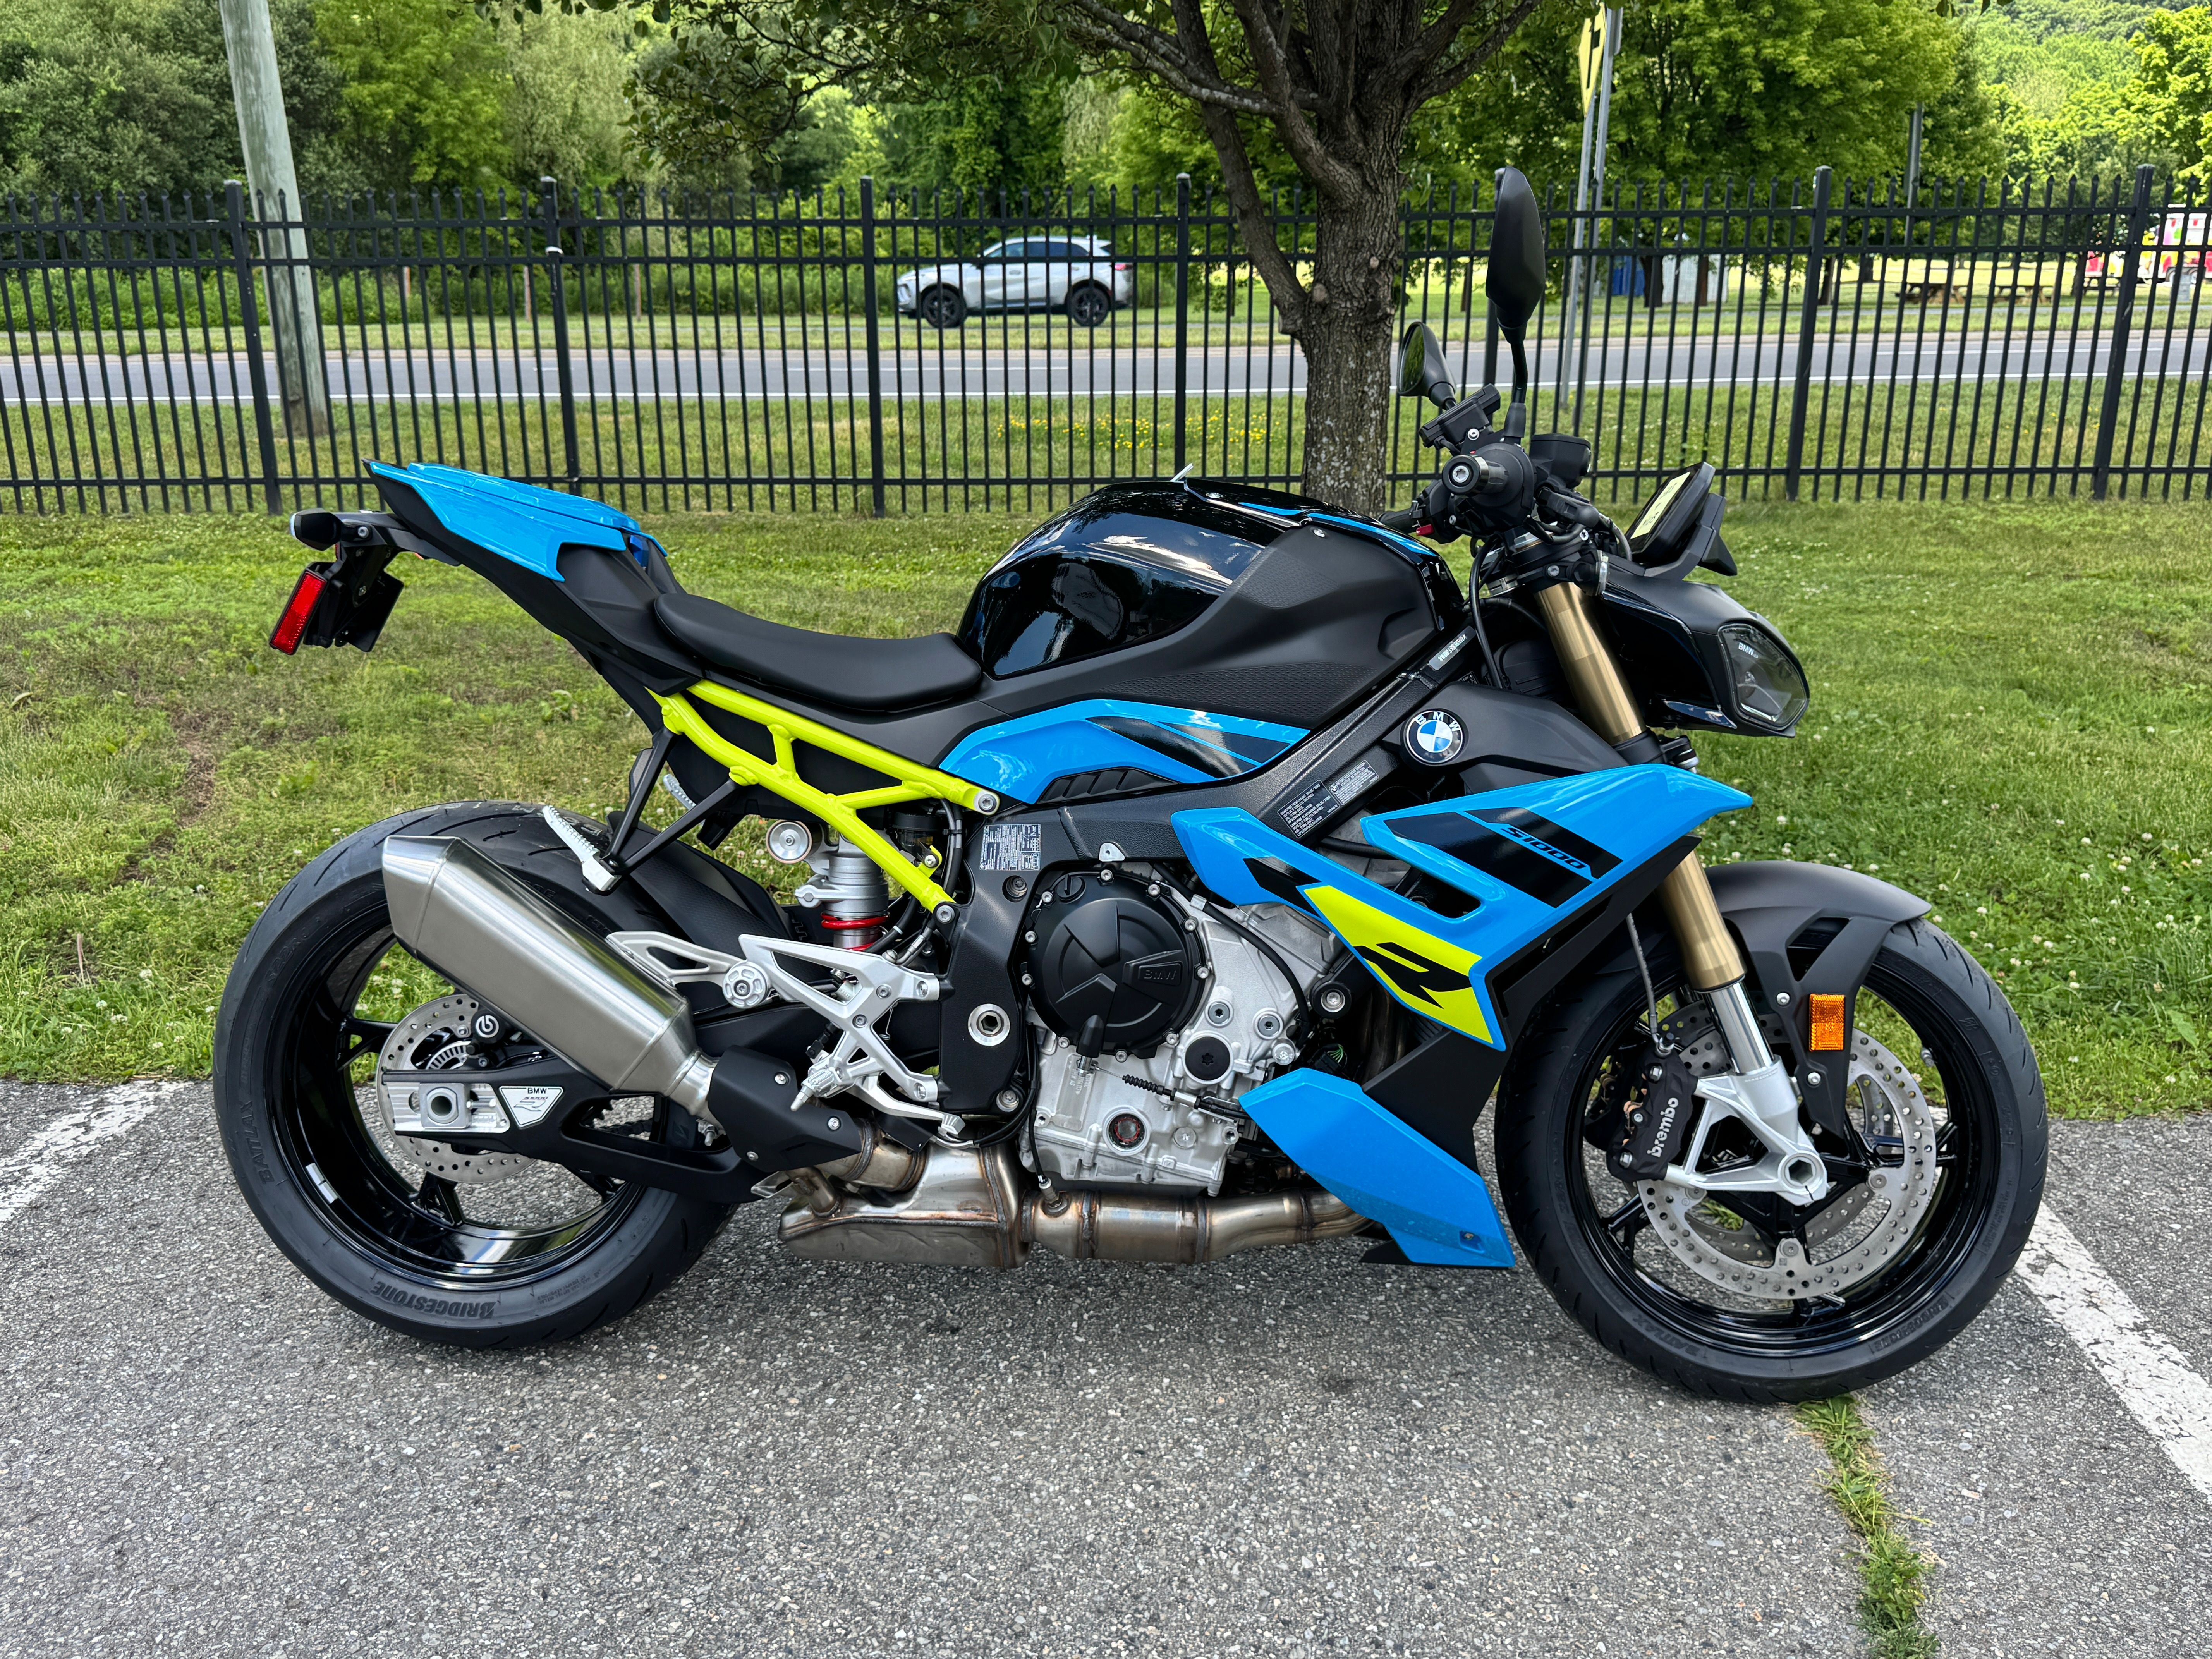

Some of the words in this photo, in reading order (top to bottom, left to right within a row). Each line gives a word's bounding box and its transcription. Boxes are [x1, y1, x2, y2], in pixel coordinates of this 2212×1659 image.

[1738, 642, 1754, 656] BMW
[1415, 711, 1461, 732] BMW
[1501, 827, 1587, 869] S1000
[1144, 969, 1177, 980] BMW
[1647, 1097, 1679, 1158] brembo
[370, 1280, 496, 1319] BRIDGESTONE
